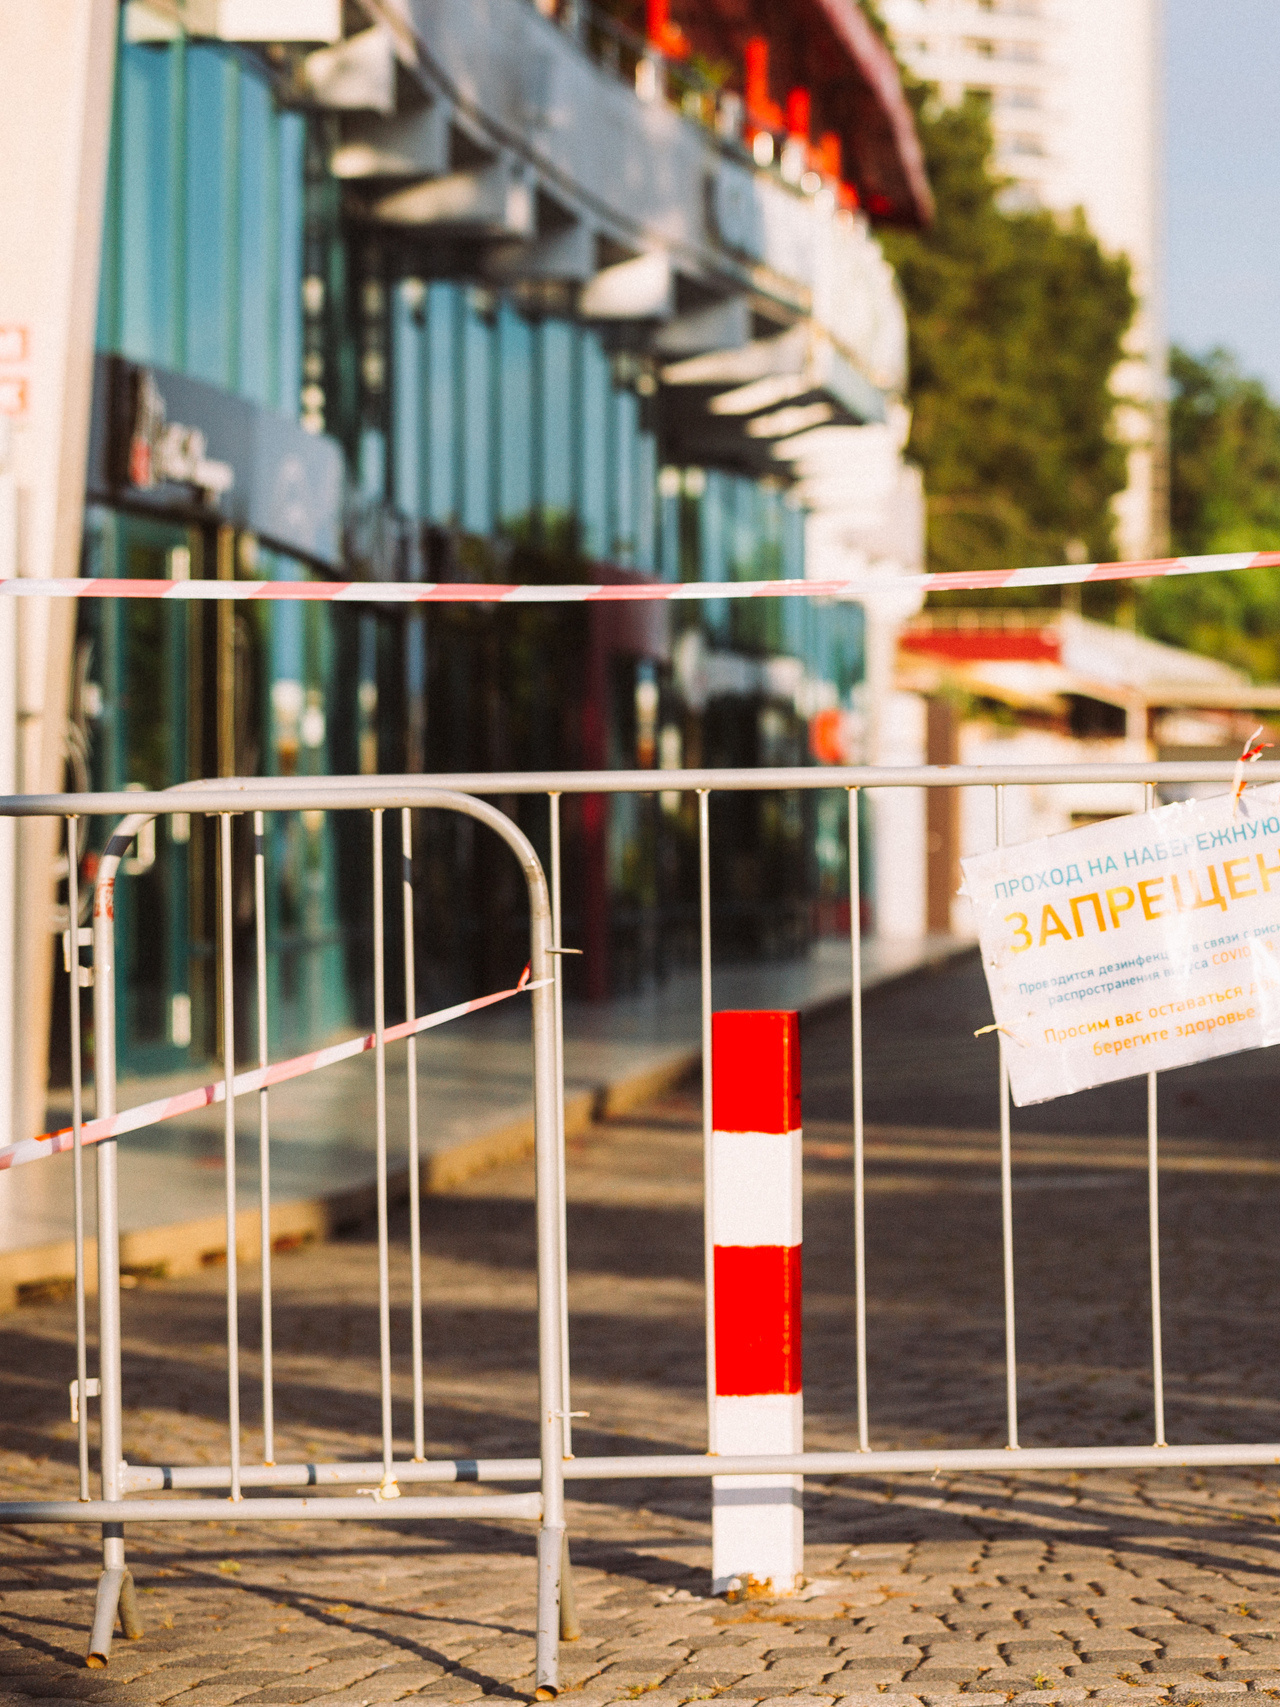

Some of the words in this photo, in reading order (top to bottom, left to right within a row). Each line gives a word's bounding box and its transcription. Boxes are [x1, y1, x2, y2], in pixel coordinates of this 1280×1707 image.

[994, 864, 1083, 899] ПРОХОД
[1088, 856, 1119, 878] НА
[1124, 816, 1280, 868] НАБЕРЕЖНУЮ
[1099, 951, 1186, 978] дезинфекц
[1203, 933, 1240, 950] связи
[1048, 971, 1160, 1008] распространения
[1044, 1019, 1110, 1045] Просим
[1115, 1011, 1143, 1028] вас
[1148, 985, 1243, 1019] оставаться
[1093, 1028, 1169, 1057] берегите
